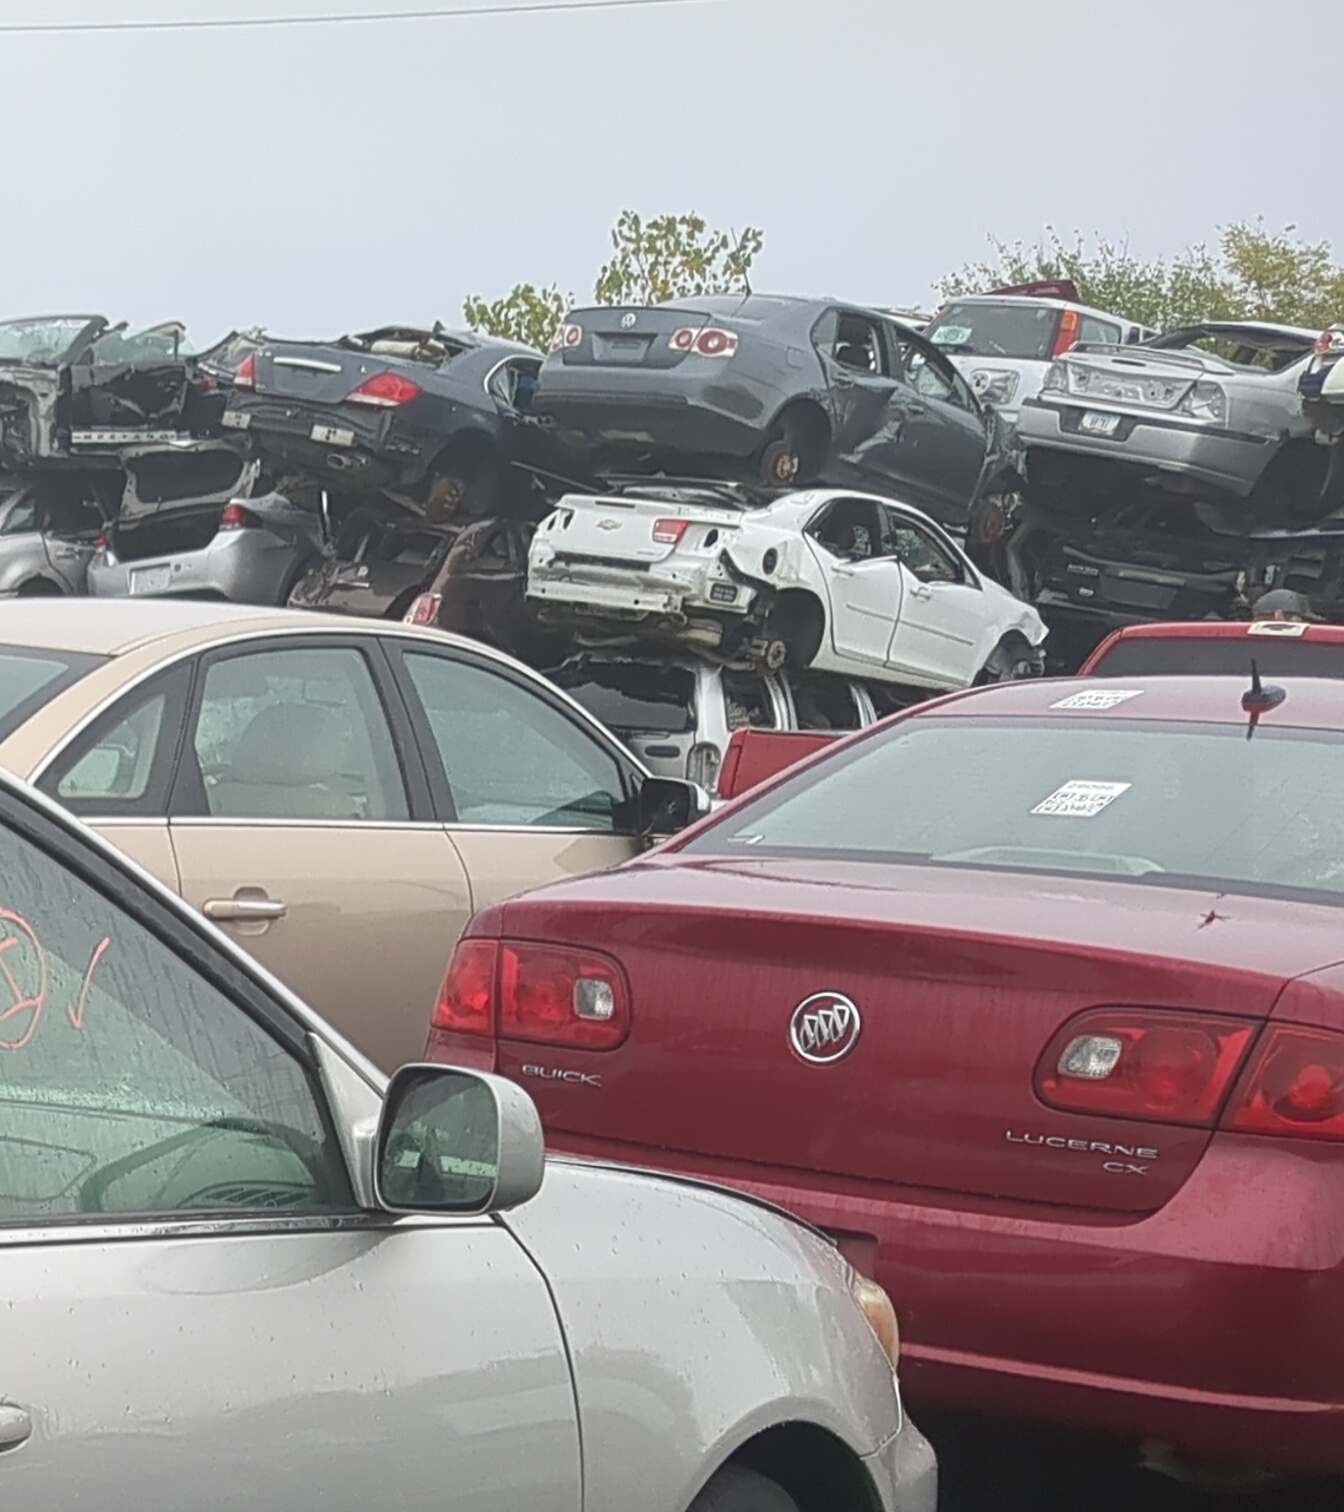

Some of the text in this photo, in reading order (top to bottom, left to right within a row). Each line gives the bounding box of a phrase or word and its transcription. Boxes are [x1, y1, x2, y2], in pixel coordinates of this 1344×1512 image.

[521, 1063, 602, 1087] BUICK
[1005, 1130, 1159, 1159] LUCERNE
[1102, 1161, 1149, 1175] CX
